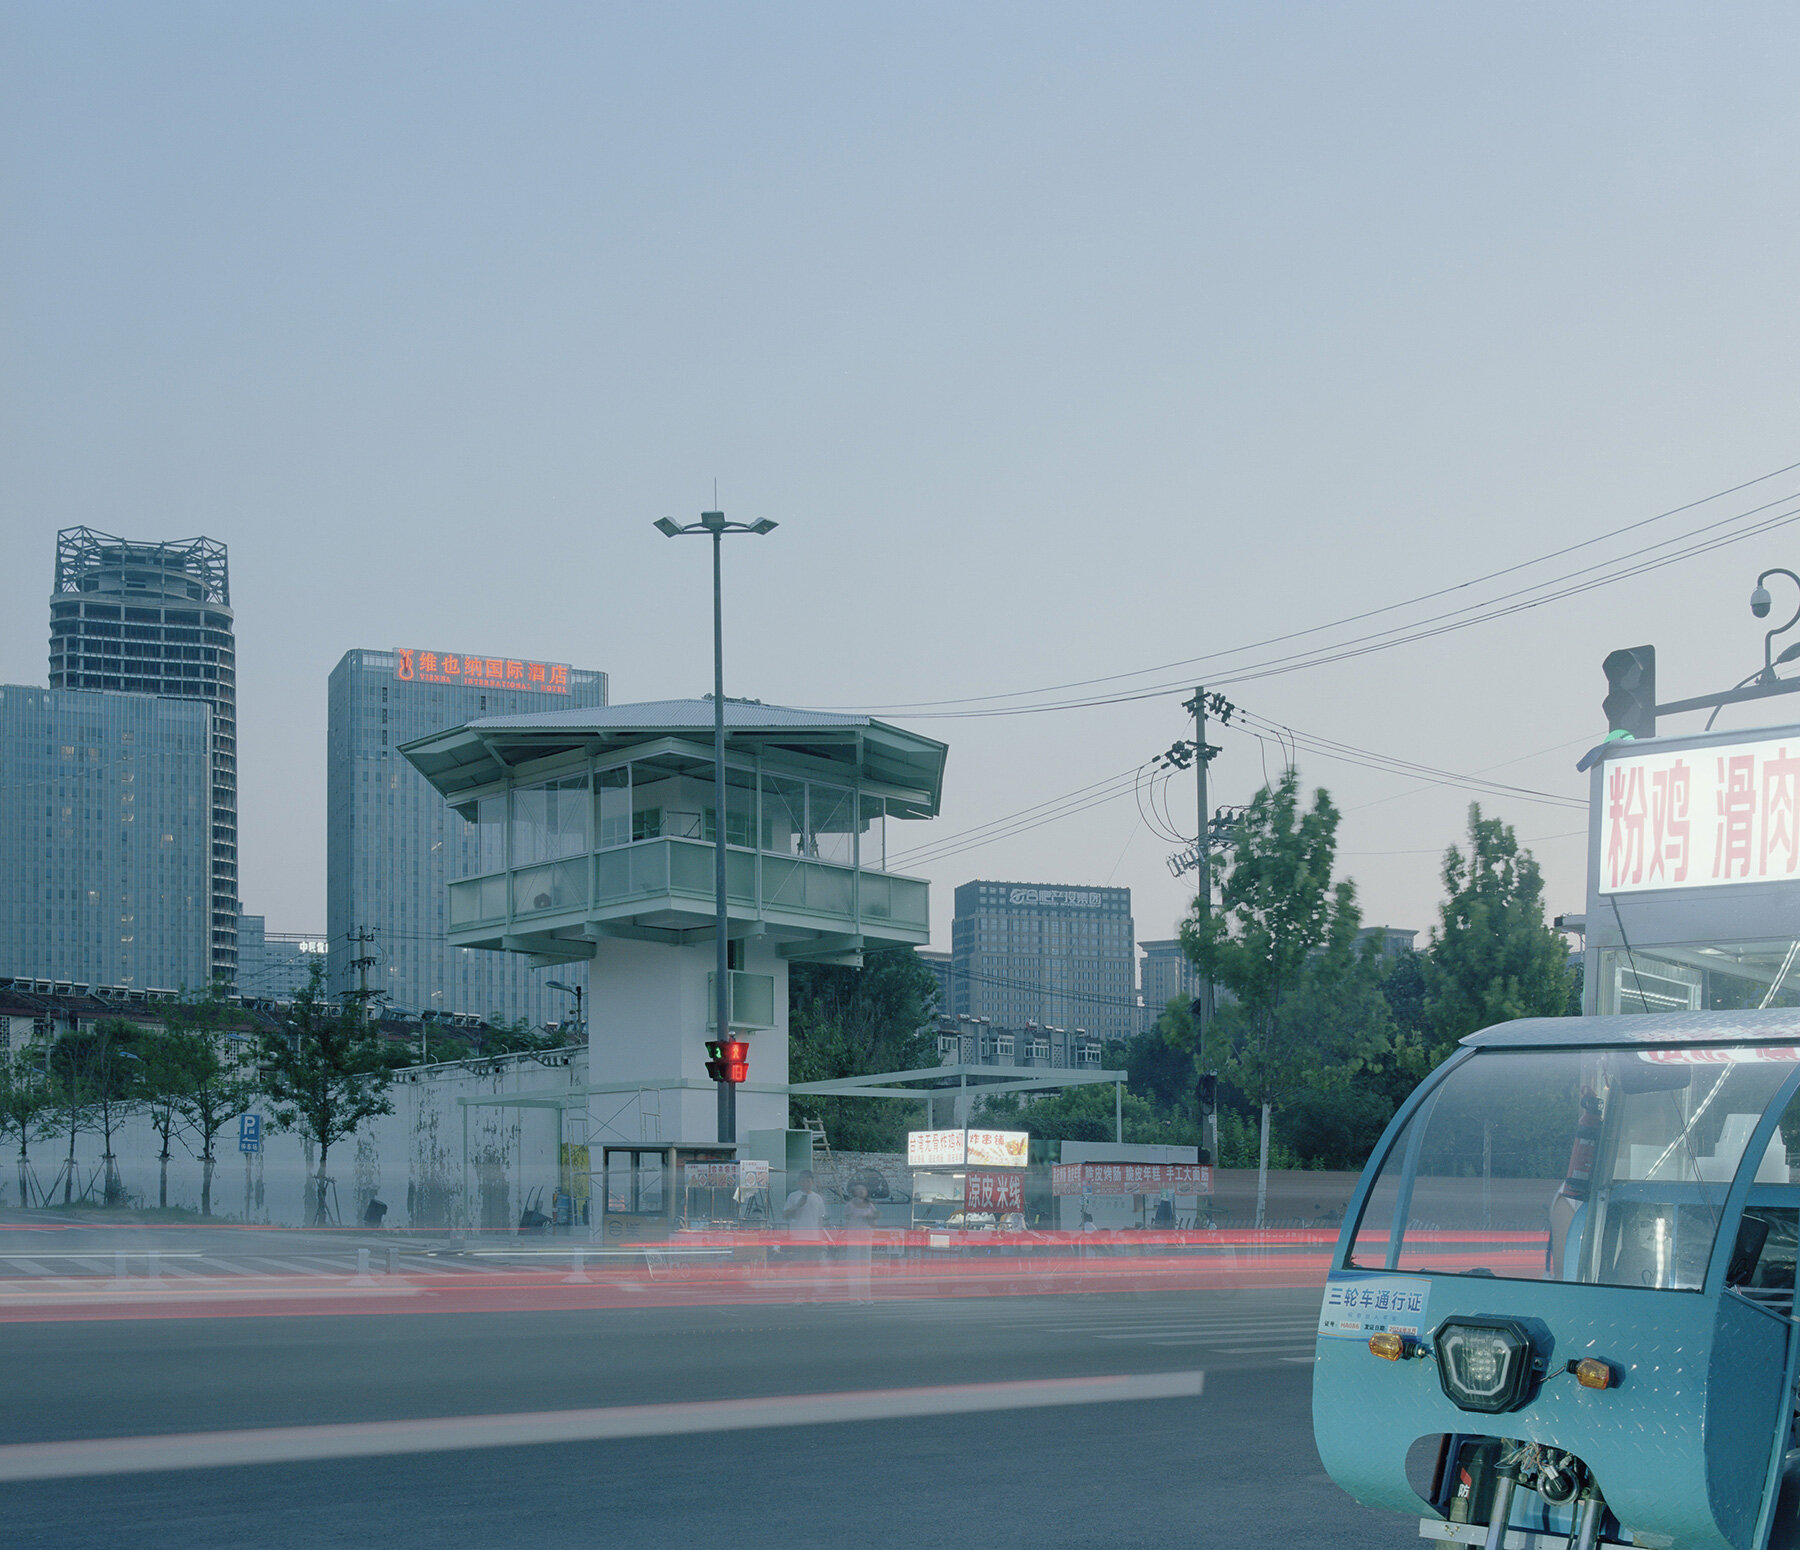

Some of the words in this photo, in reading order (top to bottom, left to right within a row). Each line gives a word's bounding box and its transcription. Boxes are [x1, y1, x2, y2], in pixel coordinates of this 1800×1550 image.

[419, 651, 568, 685] 维也纳国际酒店
[419, 673, 450, 683] VIENNA
[464, 677, 532, 691] INTERNATIONAL
[540, 684, 567, 694] HOTEL
[1607, 758, 1691, 888] 粉鸡
[1711, 746, 1800, 879] 滑肉
[244, 1116, 256, 1135] P
[1328, 1287, 1423, 1312] 三轮车通行证
